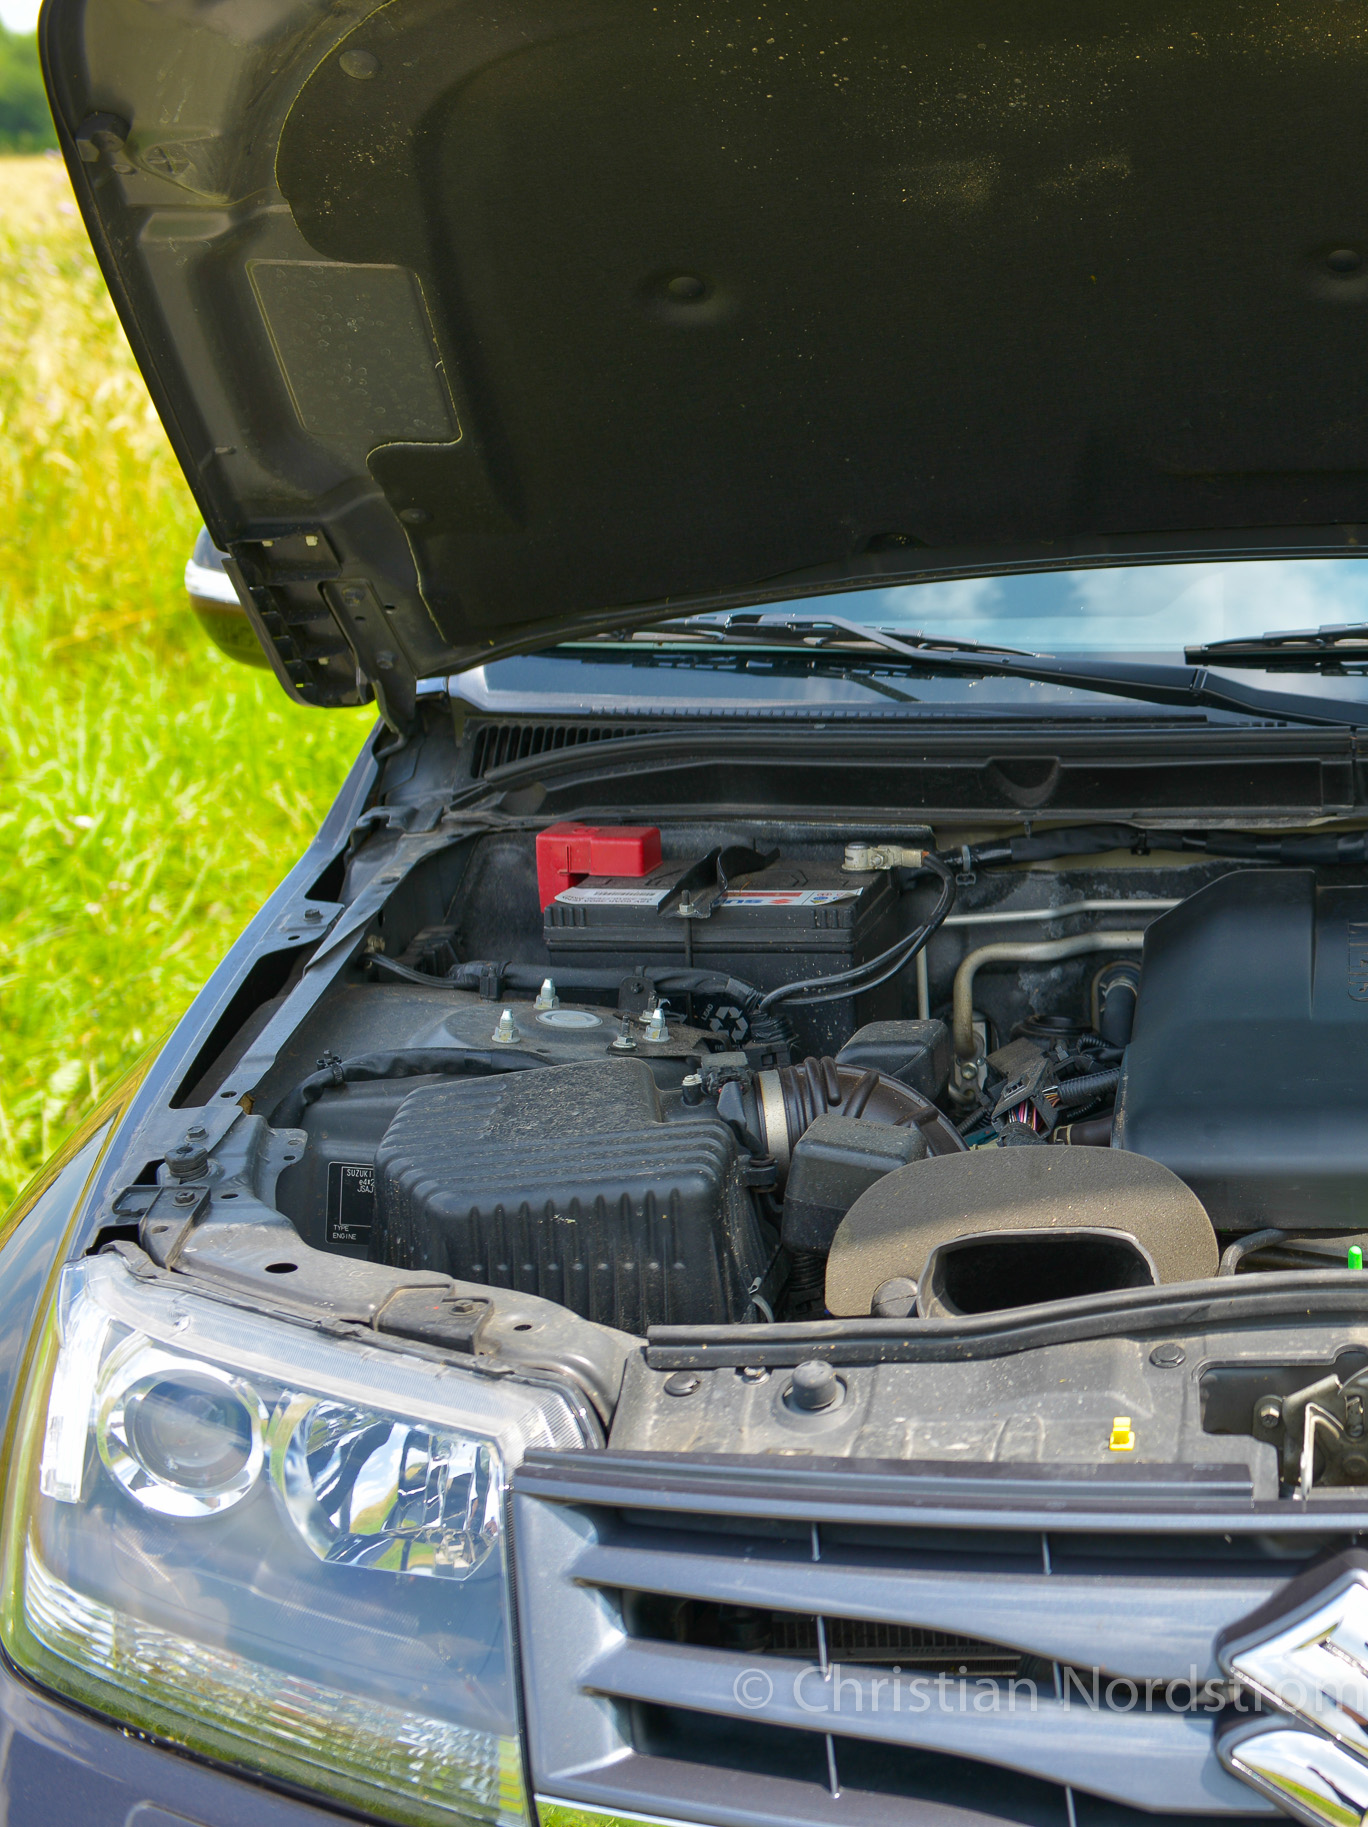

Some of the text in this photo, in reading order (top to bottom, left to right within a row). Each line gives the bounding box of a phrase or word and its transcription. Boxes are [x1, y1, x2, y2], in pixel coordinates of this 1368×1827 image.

[701, 1003, 714, 1020] LEAD
[346, 1168, 371, 1178] SUZUKI
[333, 1224, 349, 1232] TYPE
[332, 1232, 356, 1240] ENGINE
